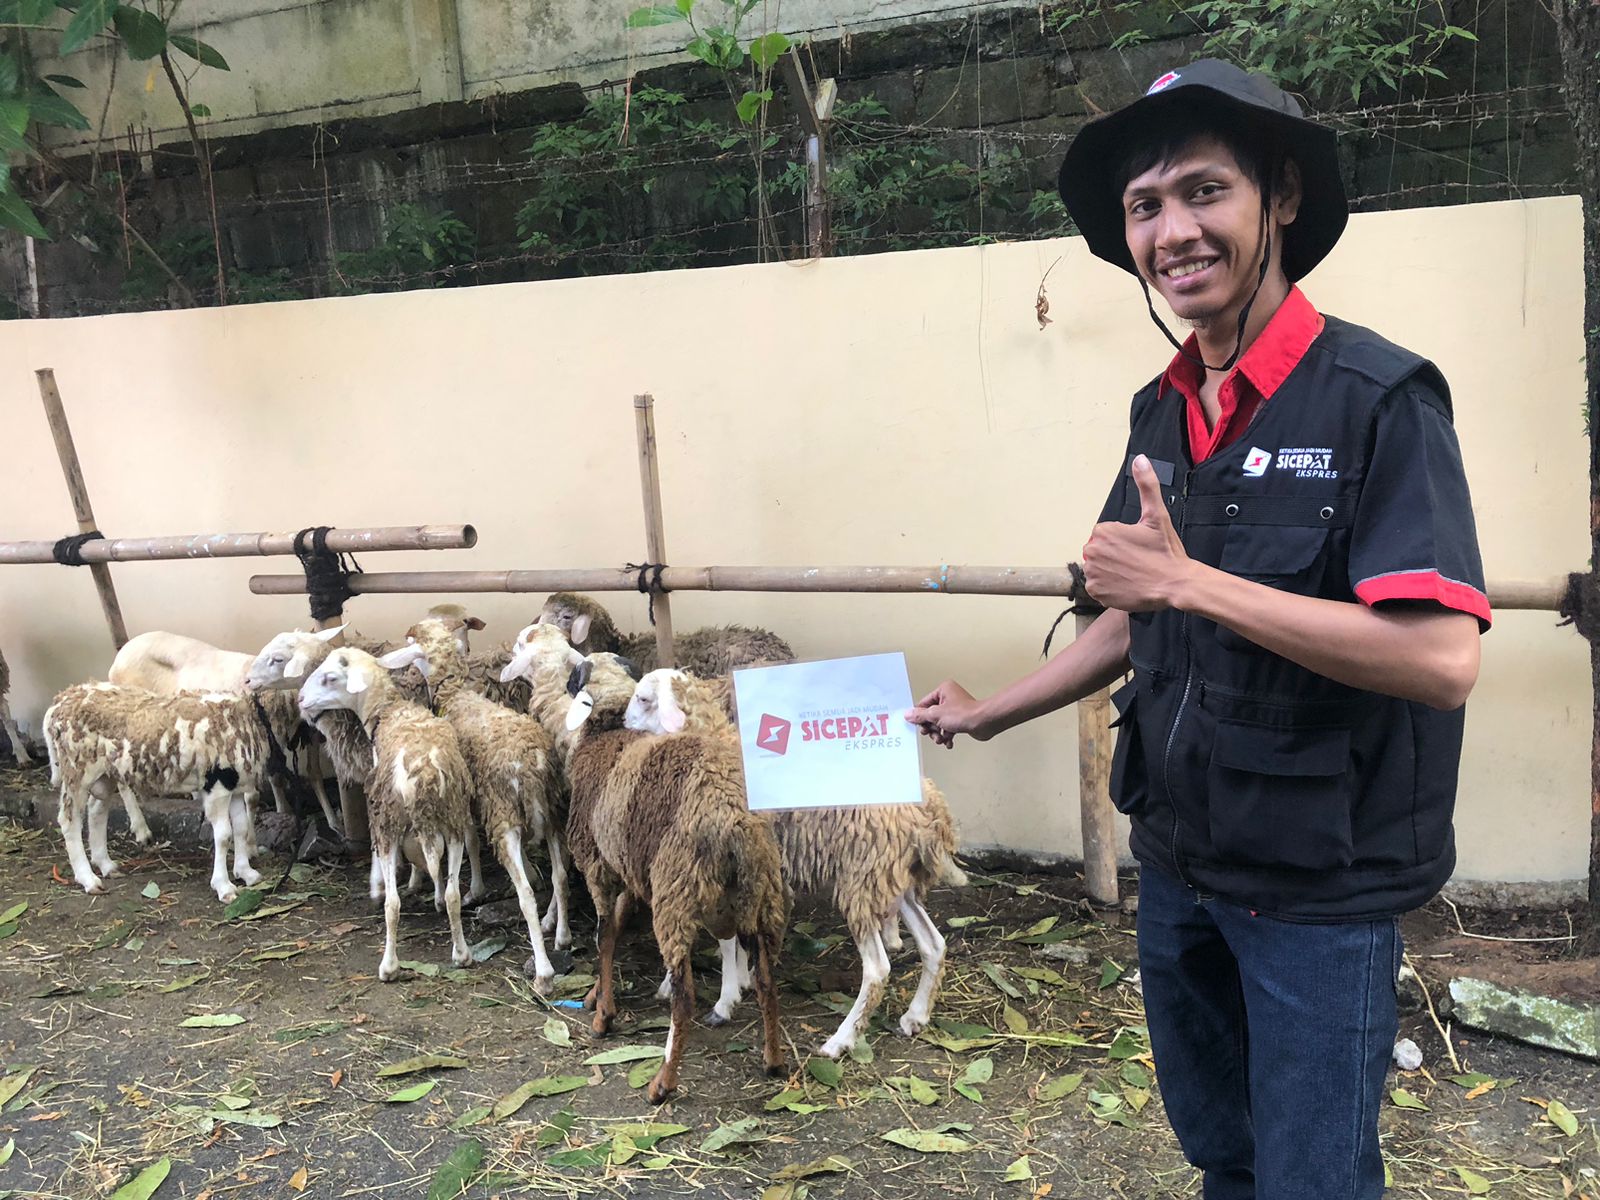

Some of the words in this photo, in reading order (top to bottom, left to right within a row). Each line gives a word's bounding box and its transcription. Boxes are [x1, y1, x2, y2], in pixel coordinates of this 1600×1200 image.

[1276, 454, 1331, 469] SICEPAT
[1295, 469, 1338, 479] EKSPRES
[801, 714, 889, 741] SICEPAT
[845, 737, 902, 751] EKSPRES
